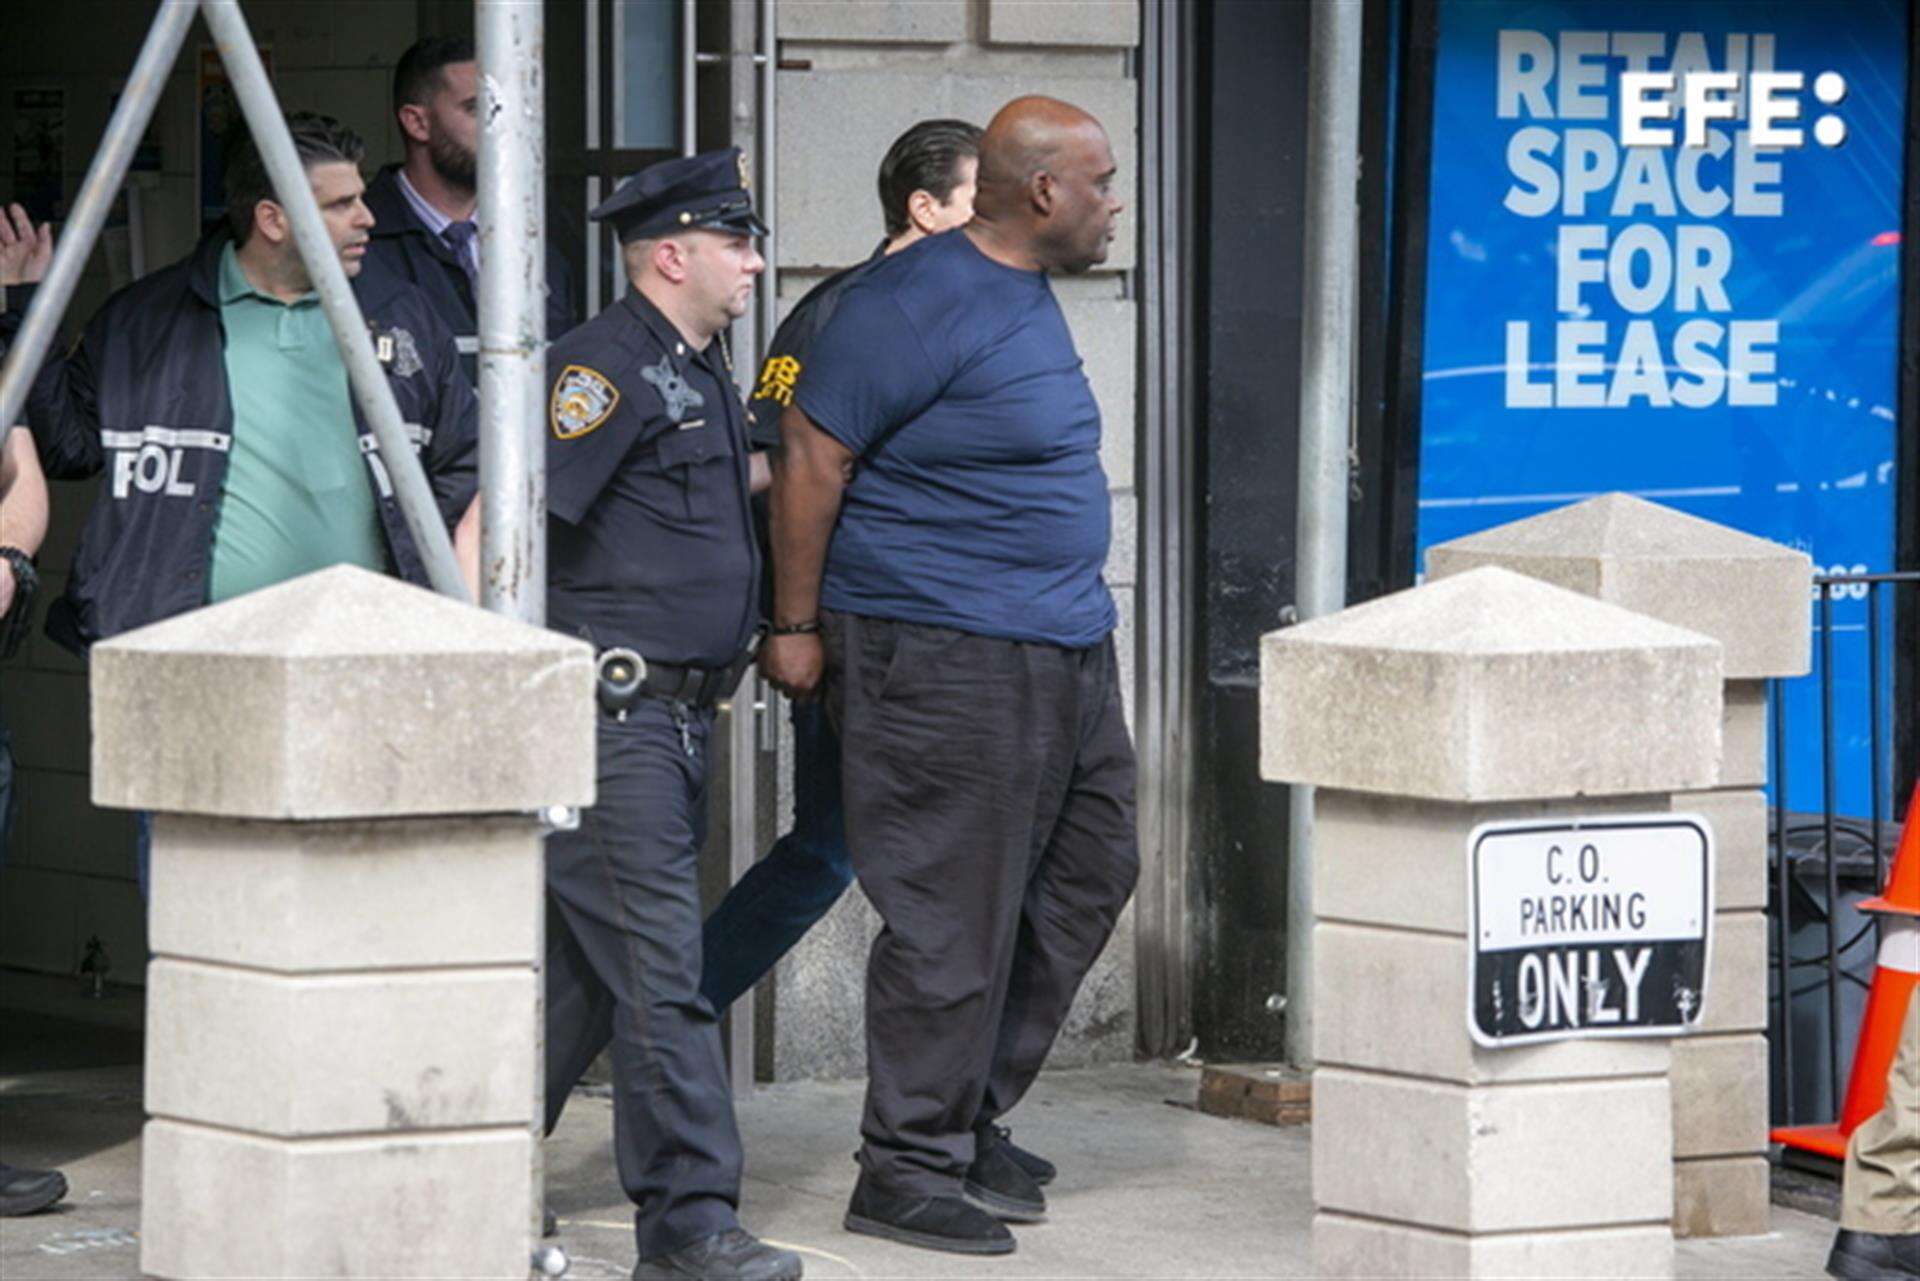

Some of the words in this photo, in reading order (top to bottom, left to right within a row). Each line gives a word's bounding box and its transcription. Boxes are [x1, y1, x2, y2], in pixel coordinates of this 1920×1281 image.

[1503, 126, 1785, 218] SPACE
[1557, 223, 1734, 314] FOR
[1505, 319, 1780, 409] LEASE
[112, 443, 196, 499] POL
[1546, 844, 1610, 885] C.O.
[1520, 891, 1647, 935] PARKING
[1517, 948, 1653, 1029] ONLY
